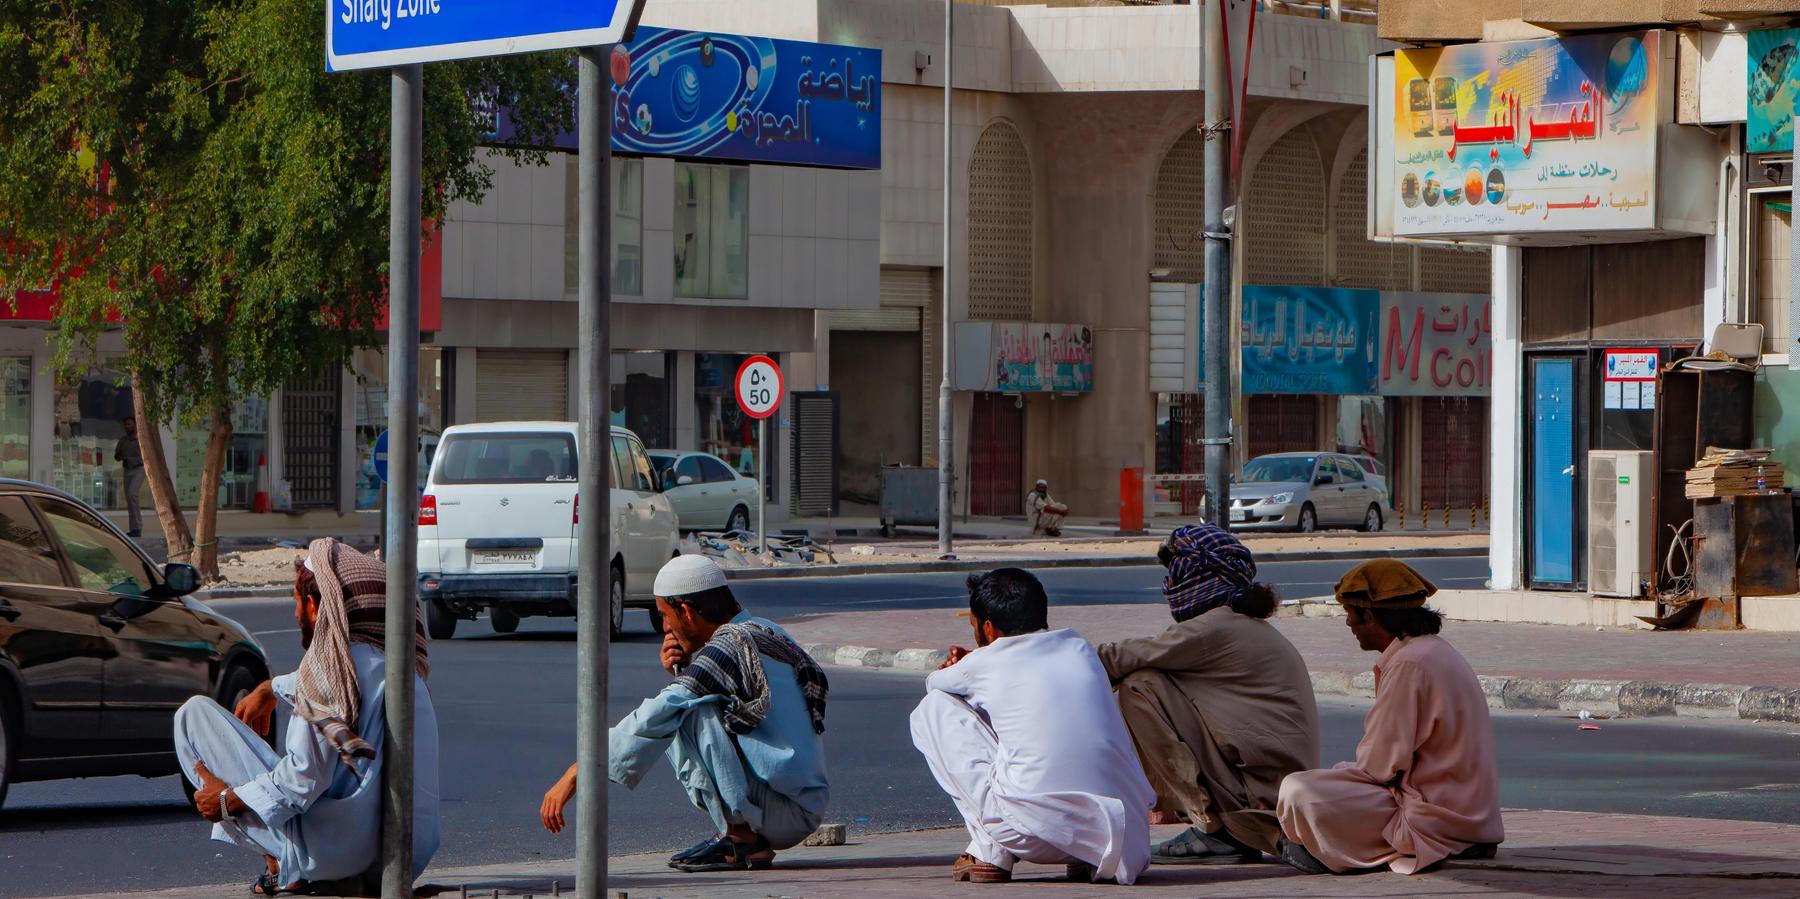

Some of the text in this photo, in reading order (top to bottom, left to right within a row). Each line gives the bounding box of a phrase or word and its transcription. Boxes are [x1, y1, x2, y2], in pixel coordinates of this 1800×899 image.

[798, 55, 875, 112] رياضة
[740, 97, 811, 147] المجرة
[1522, 79, 1604, 159] القمر
[1578, 160, 1618, 181] رحلات
[1543, 194, 1601, 220] مصر
[1242, 297, 1287, 361] للرياض
[1383, 305, 1425, 382] M
[1432, 302, 1491, 346] ارات
[751, 369, 767, 386] ٥٠
[1430, 347, 1492, 388] Coll
[750, 389, 770, 406] 50
